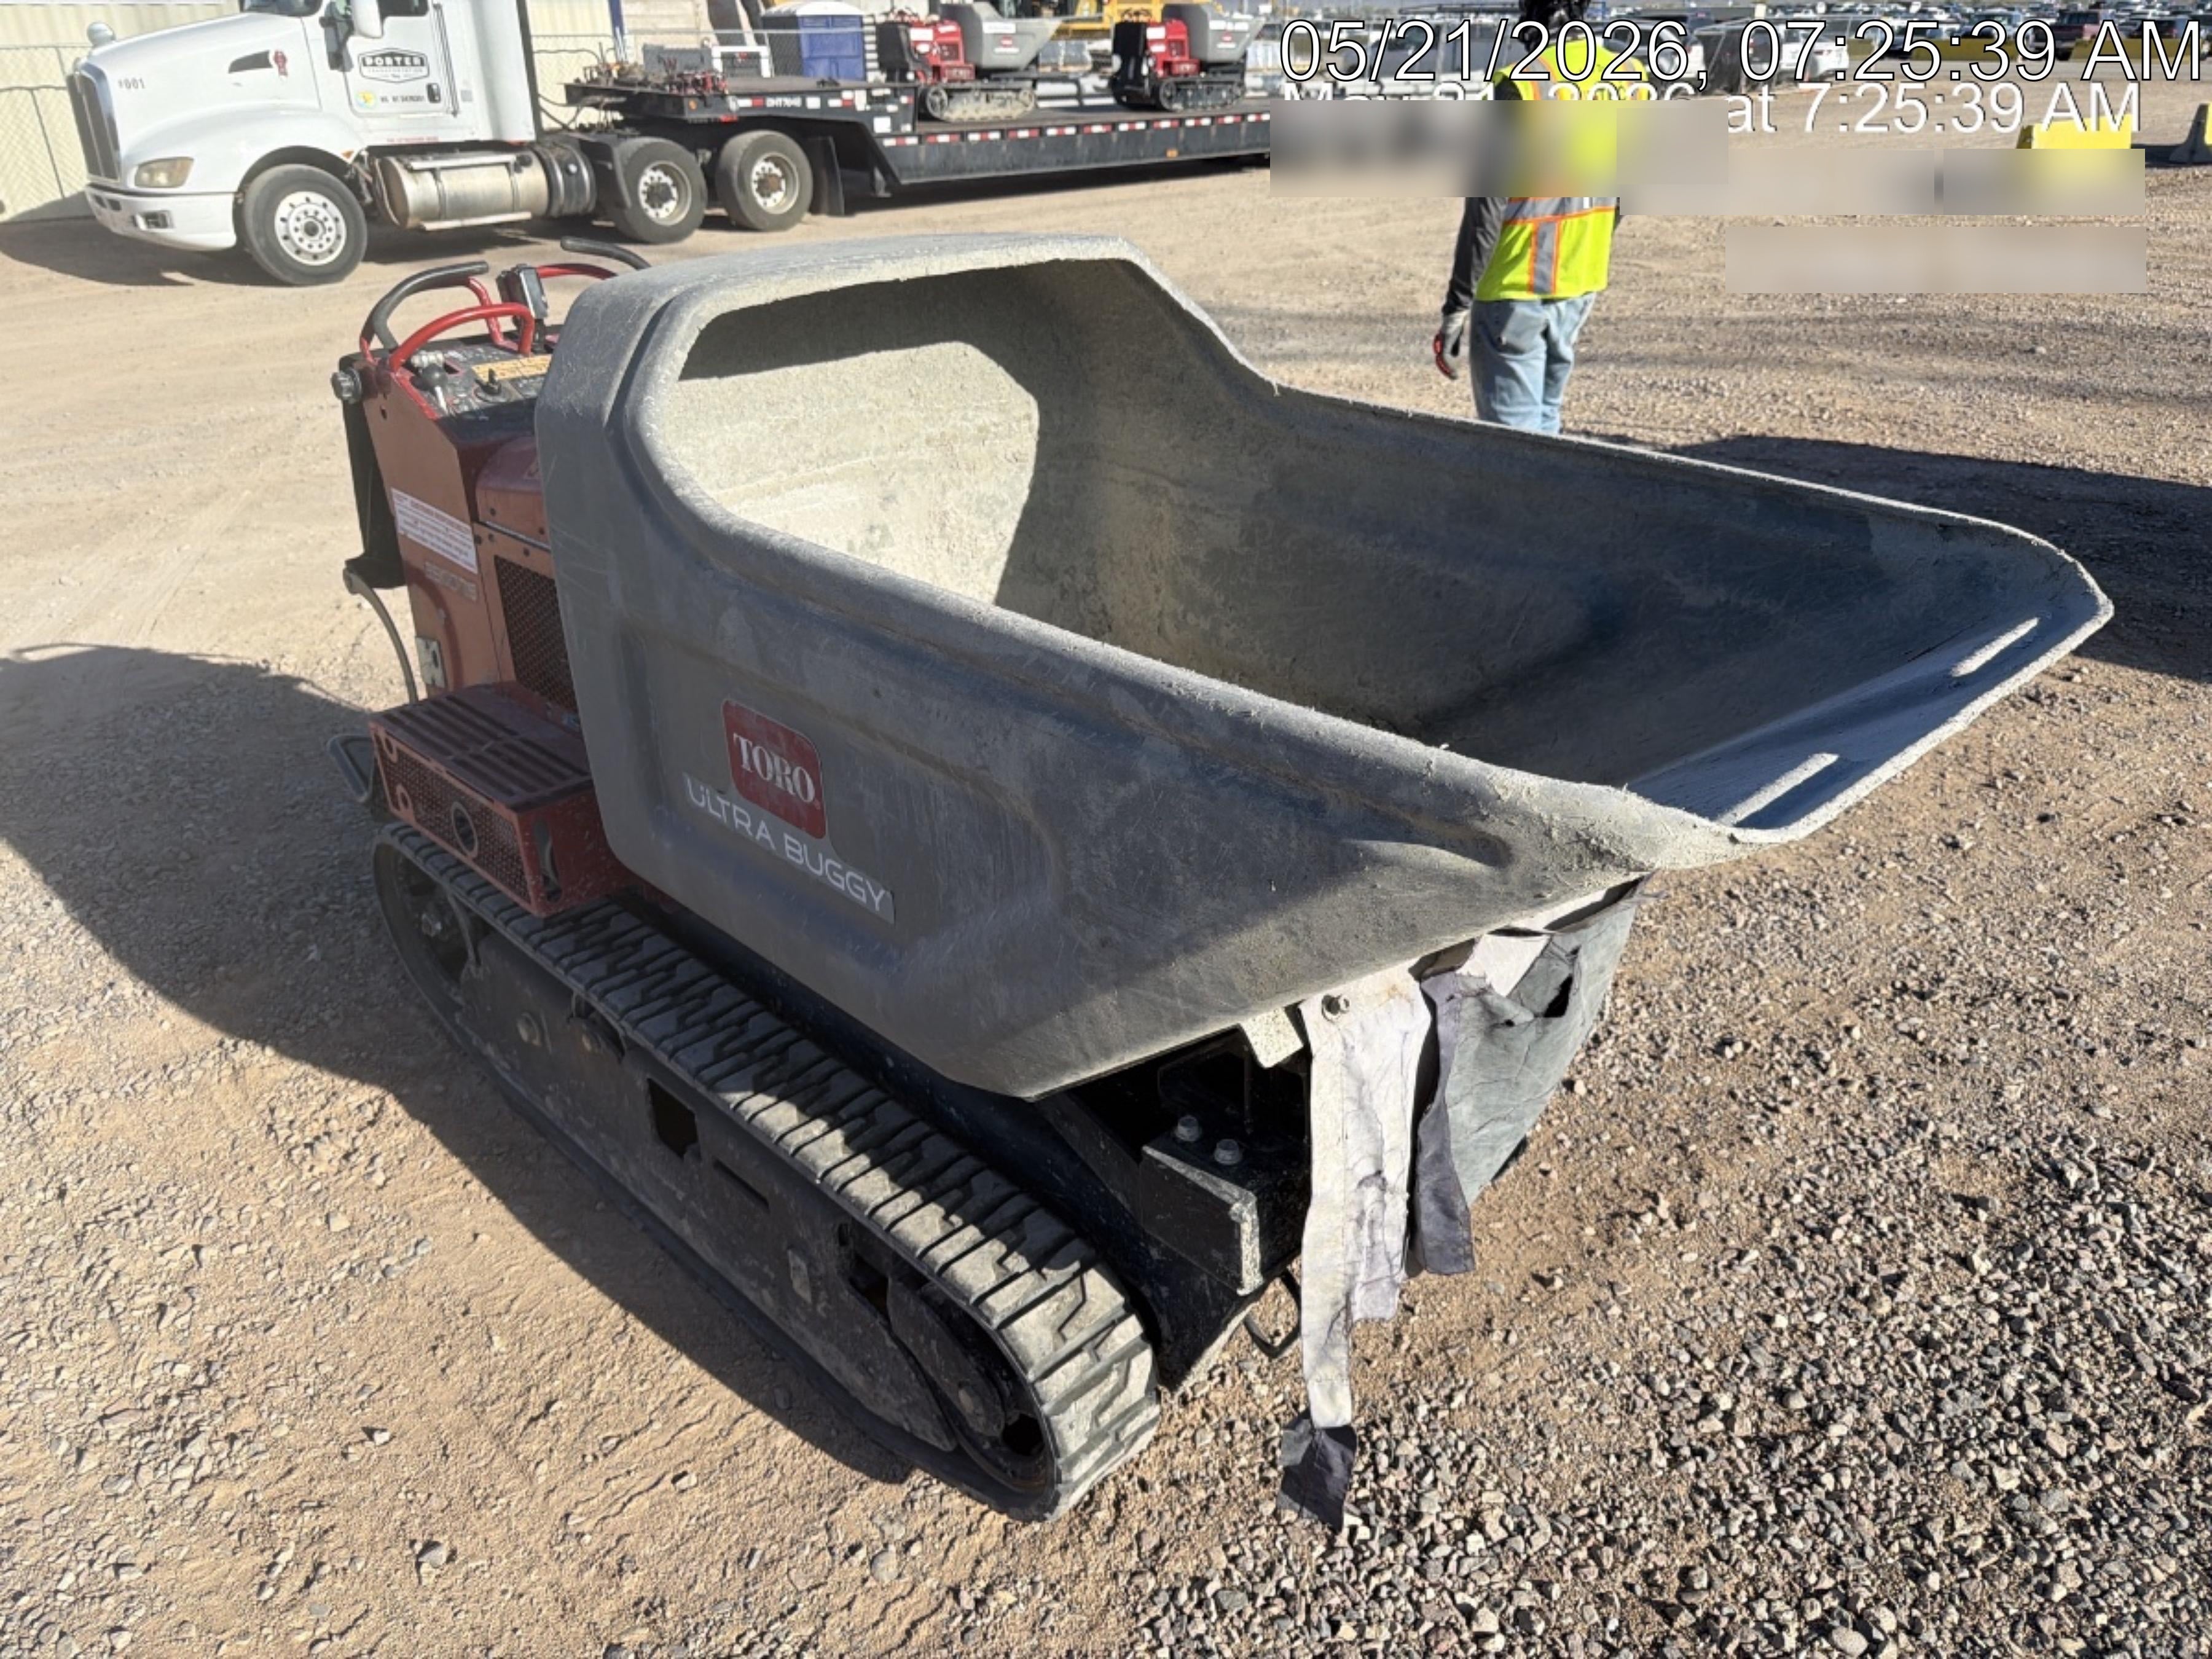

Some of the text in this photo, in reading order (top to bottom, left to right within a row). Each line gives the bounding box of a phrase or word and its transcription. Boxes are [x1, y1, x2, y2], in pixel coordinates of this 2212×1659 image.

[364, 55, 422, 66] PORTER
[733, 732, 816, 803] TORO
[683, 773, 886, 912] ULTRA BUGGY
